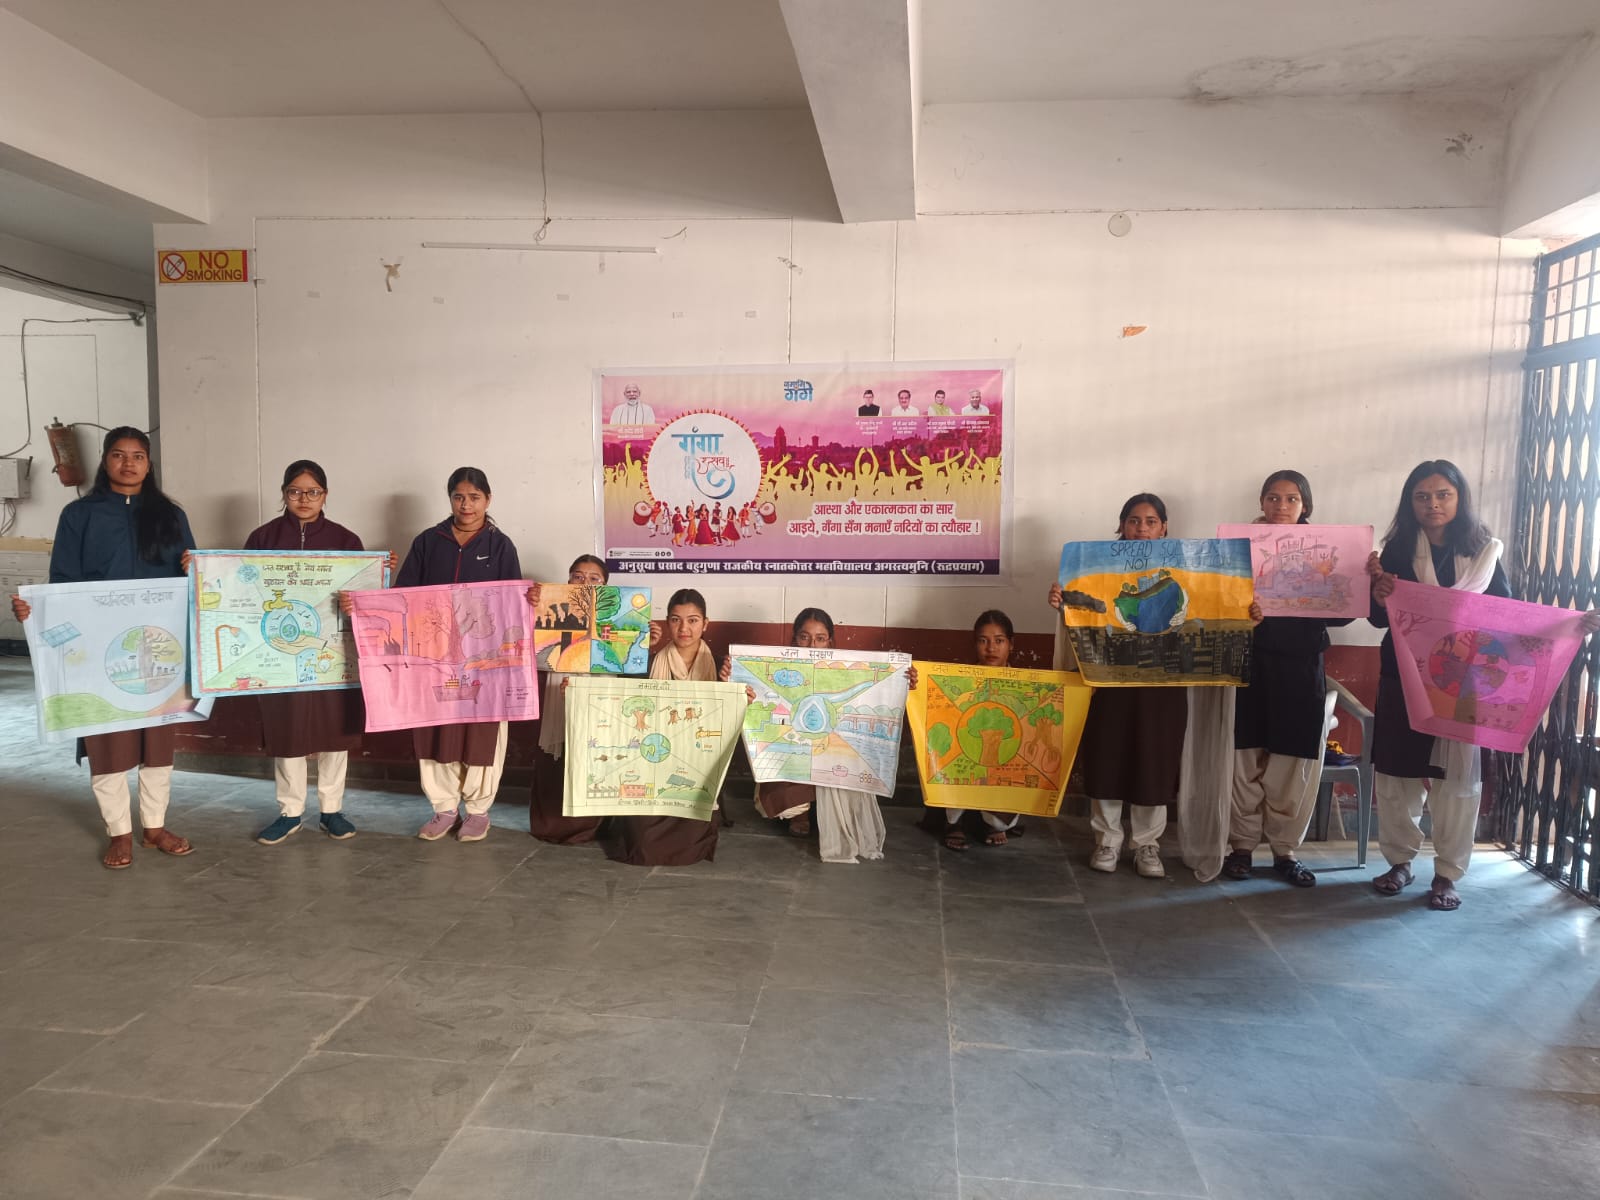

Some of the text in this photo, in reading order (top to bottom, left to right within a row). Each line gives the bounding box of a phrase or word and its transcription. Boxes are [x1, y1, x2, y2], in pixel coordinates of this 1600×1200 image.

[199, 251, 229, 269] NO
[186, 269, 242, 281] SMOKING
[671, 426, 725, 455] गंगा
[814, 500, 953, 515] आस्था और एकात्मकता का सार
[789, 520, 819, 535] आइये,
[894, 519, 923, 533] नदियों
[925, 523, 938, 533] का
[940, 519, 972, 533] त्यौहार
[1110, 541, 1220, 557] SPREAD SOLION
[618, 560, 656, 573] अनुसूया
[658, 560, 683, 572] प्रसाद
[686, 560, 720, 573] बहुगुणा
[723, 559, 762, 572] राजकीय
[764, 559, 813, 572] स्नातकोत्तर
[816, 560, 872, 572] महाविद्यालय
[1124, 558, 1150, 571] NOT
[780, 648, 799, 658] जल
